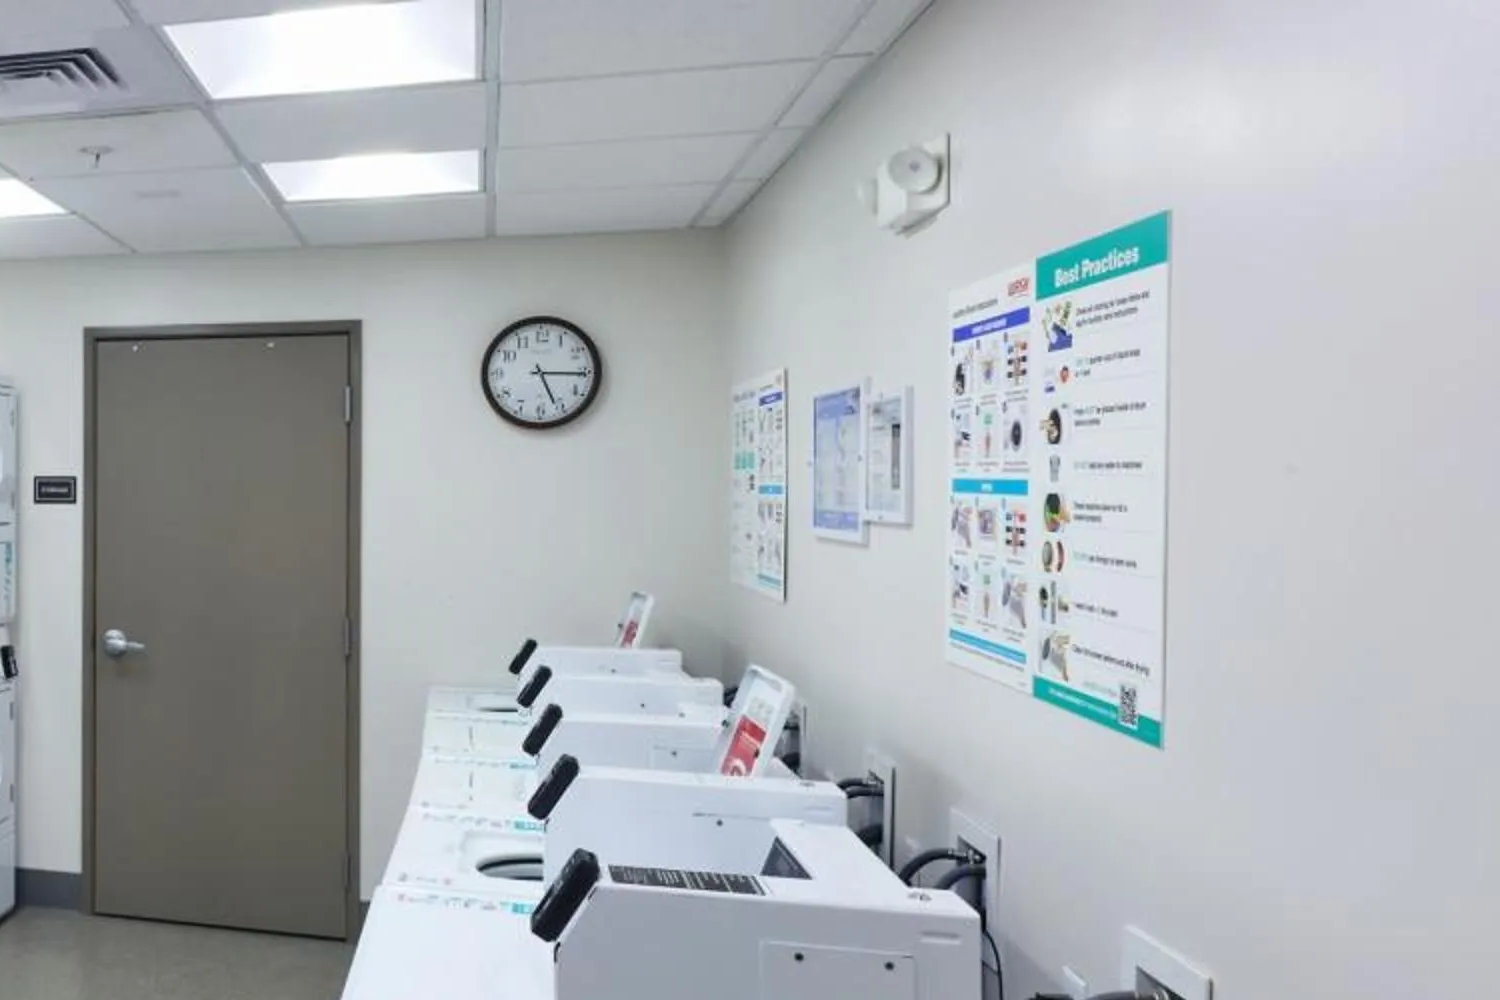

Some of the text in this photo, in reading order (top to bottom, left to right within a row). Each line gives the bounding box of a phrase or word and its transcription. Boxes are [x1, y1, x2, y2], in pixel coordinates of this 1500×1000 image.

[1054, 247, 1139, 288] Best Practices
[516, 335, 529, 349] 11
[535, 329, 550, 343] 12
[502, 350, 517, 364] 10
